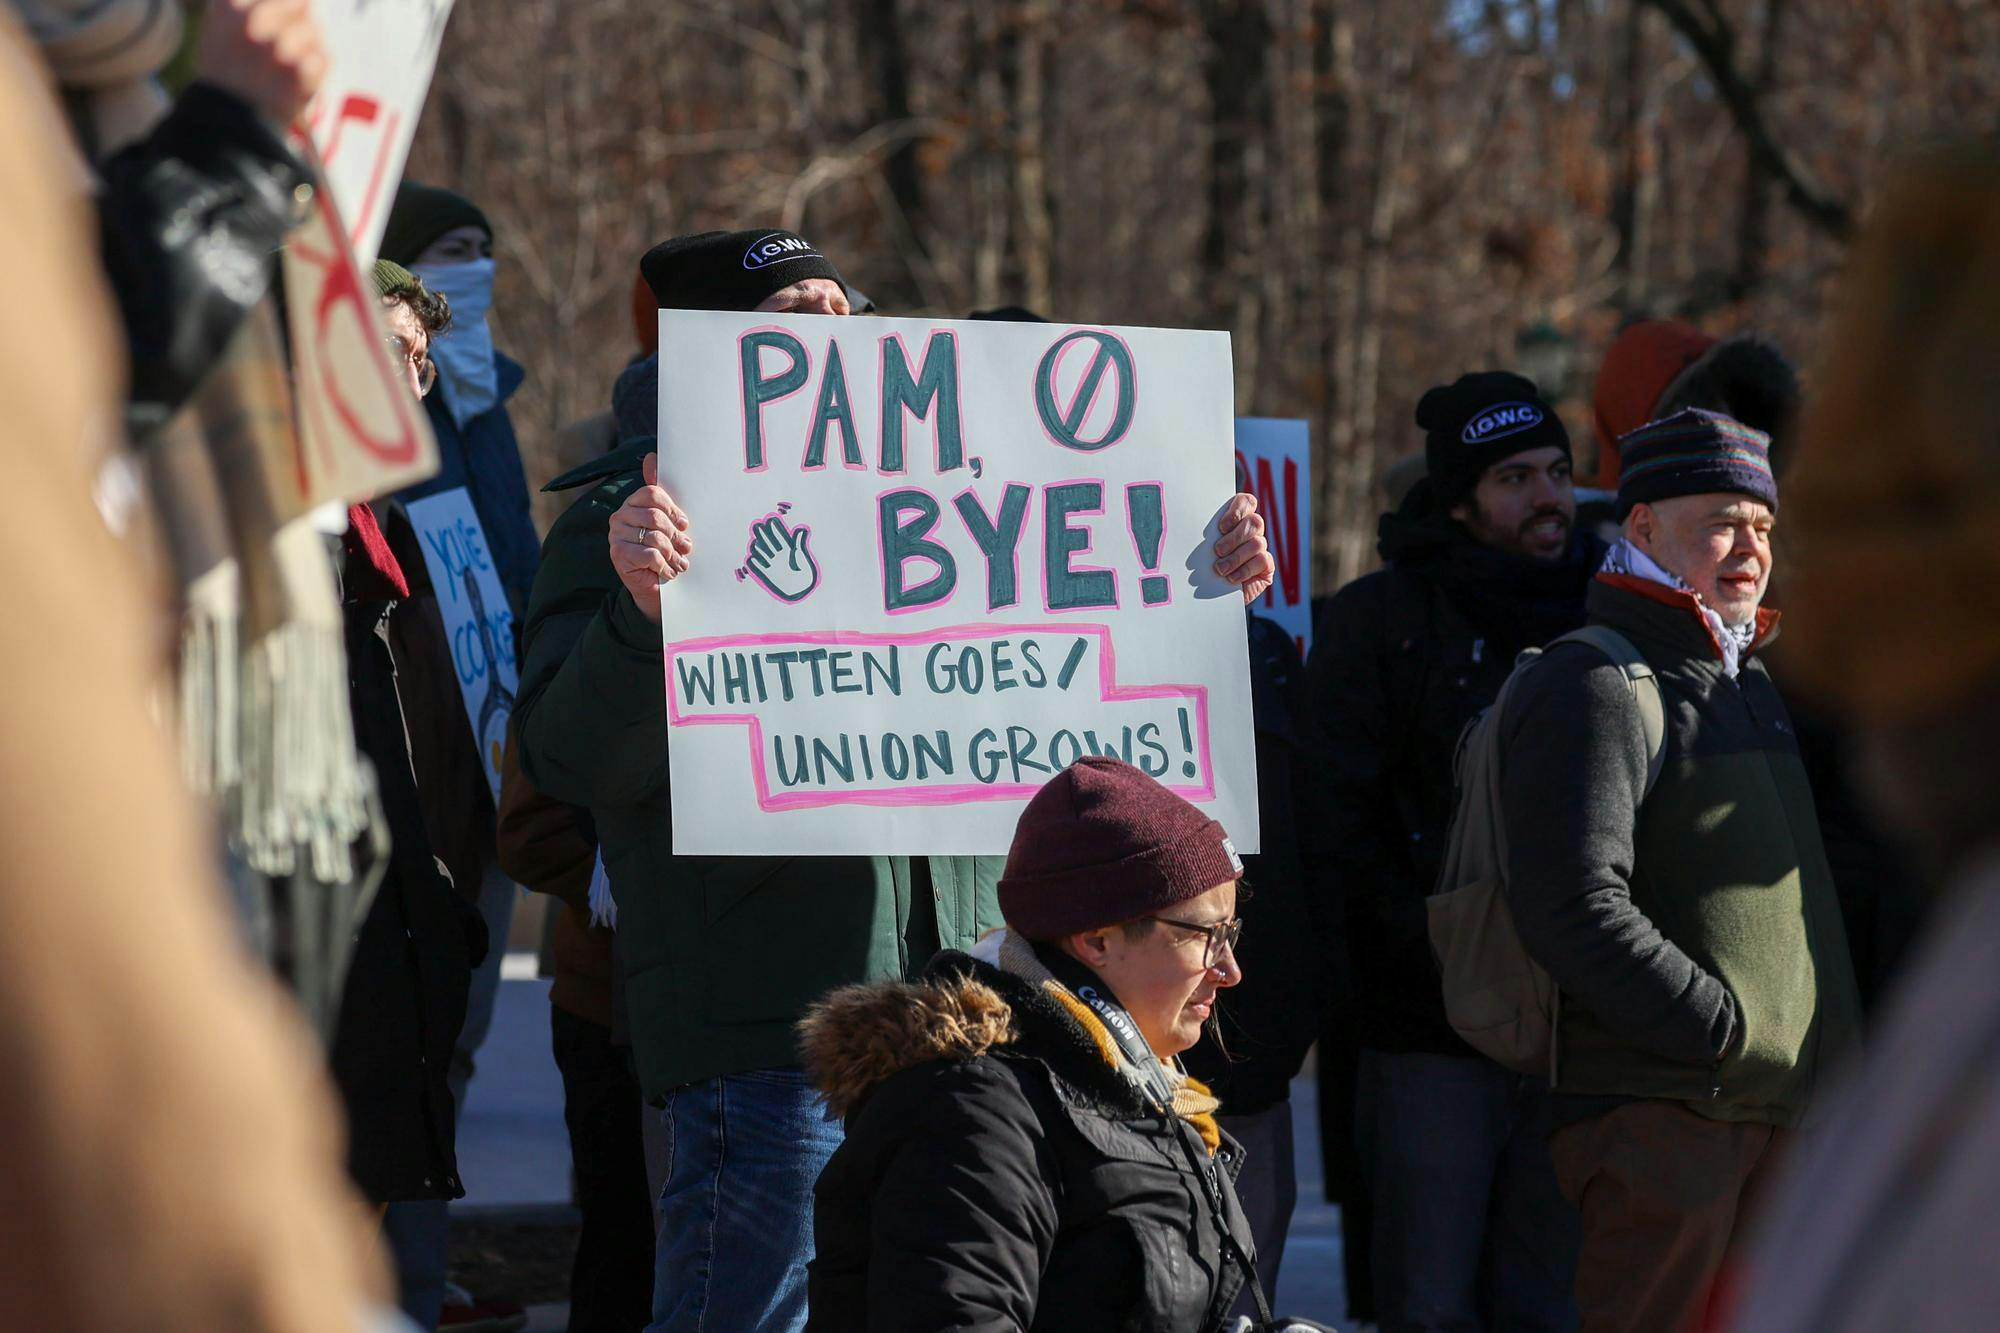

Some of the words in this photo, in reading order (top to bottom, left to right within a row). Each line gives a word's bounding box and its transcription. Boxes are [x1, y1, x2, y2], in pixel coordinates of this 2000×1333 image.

[738, 326, 984, 478] PAM,
[876, 480, 1171, 614] BYE!
[676, 645, 901, 705] WHITTEN
[774, 730, 954, 786] UNION
[1078, 986, 1135, 1040] Canon
